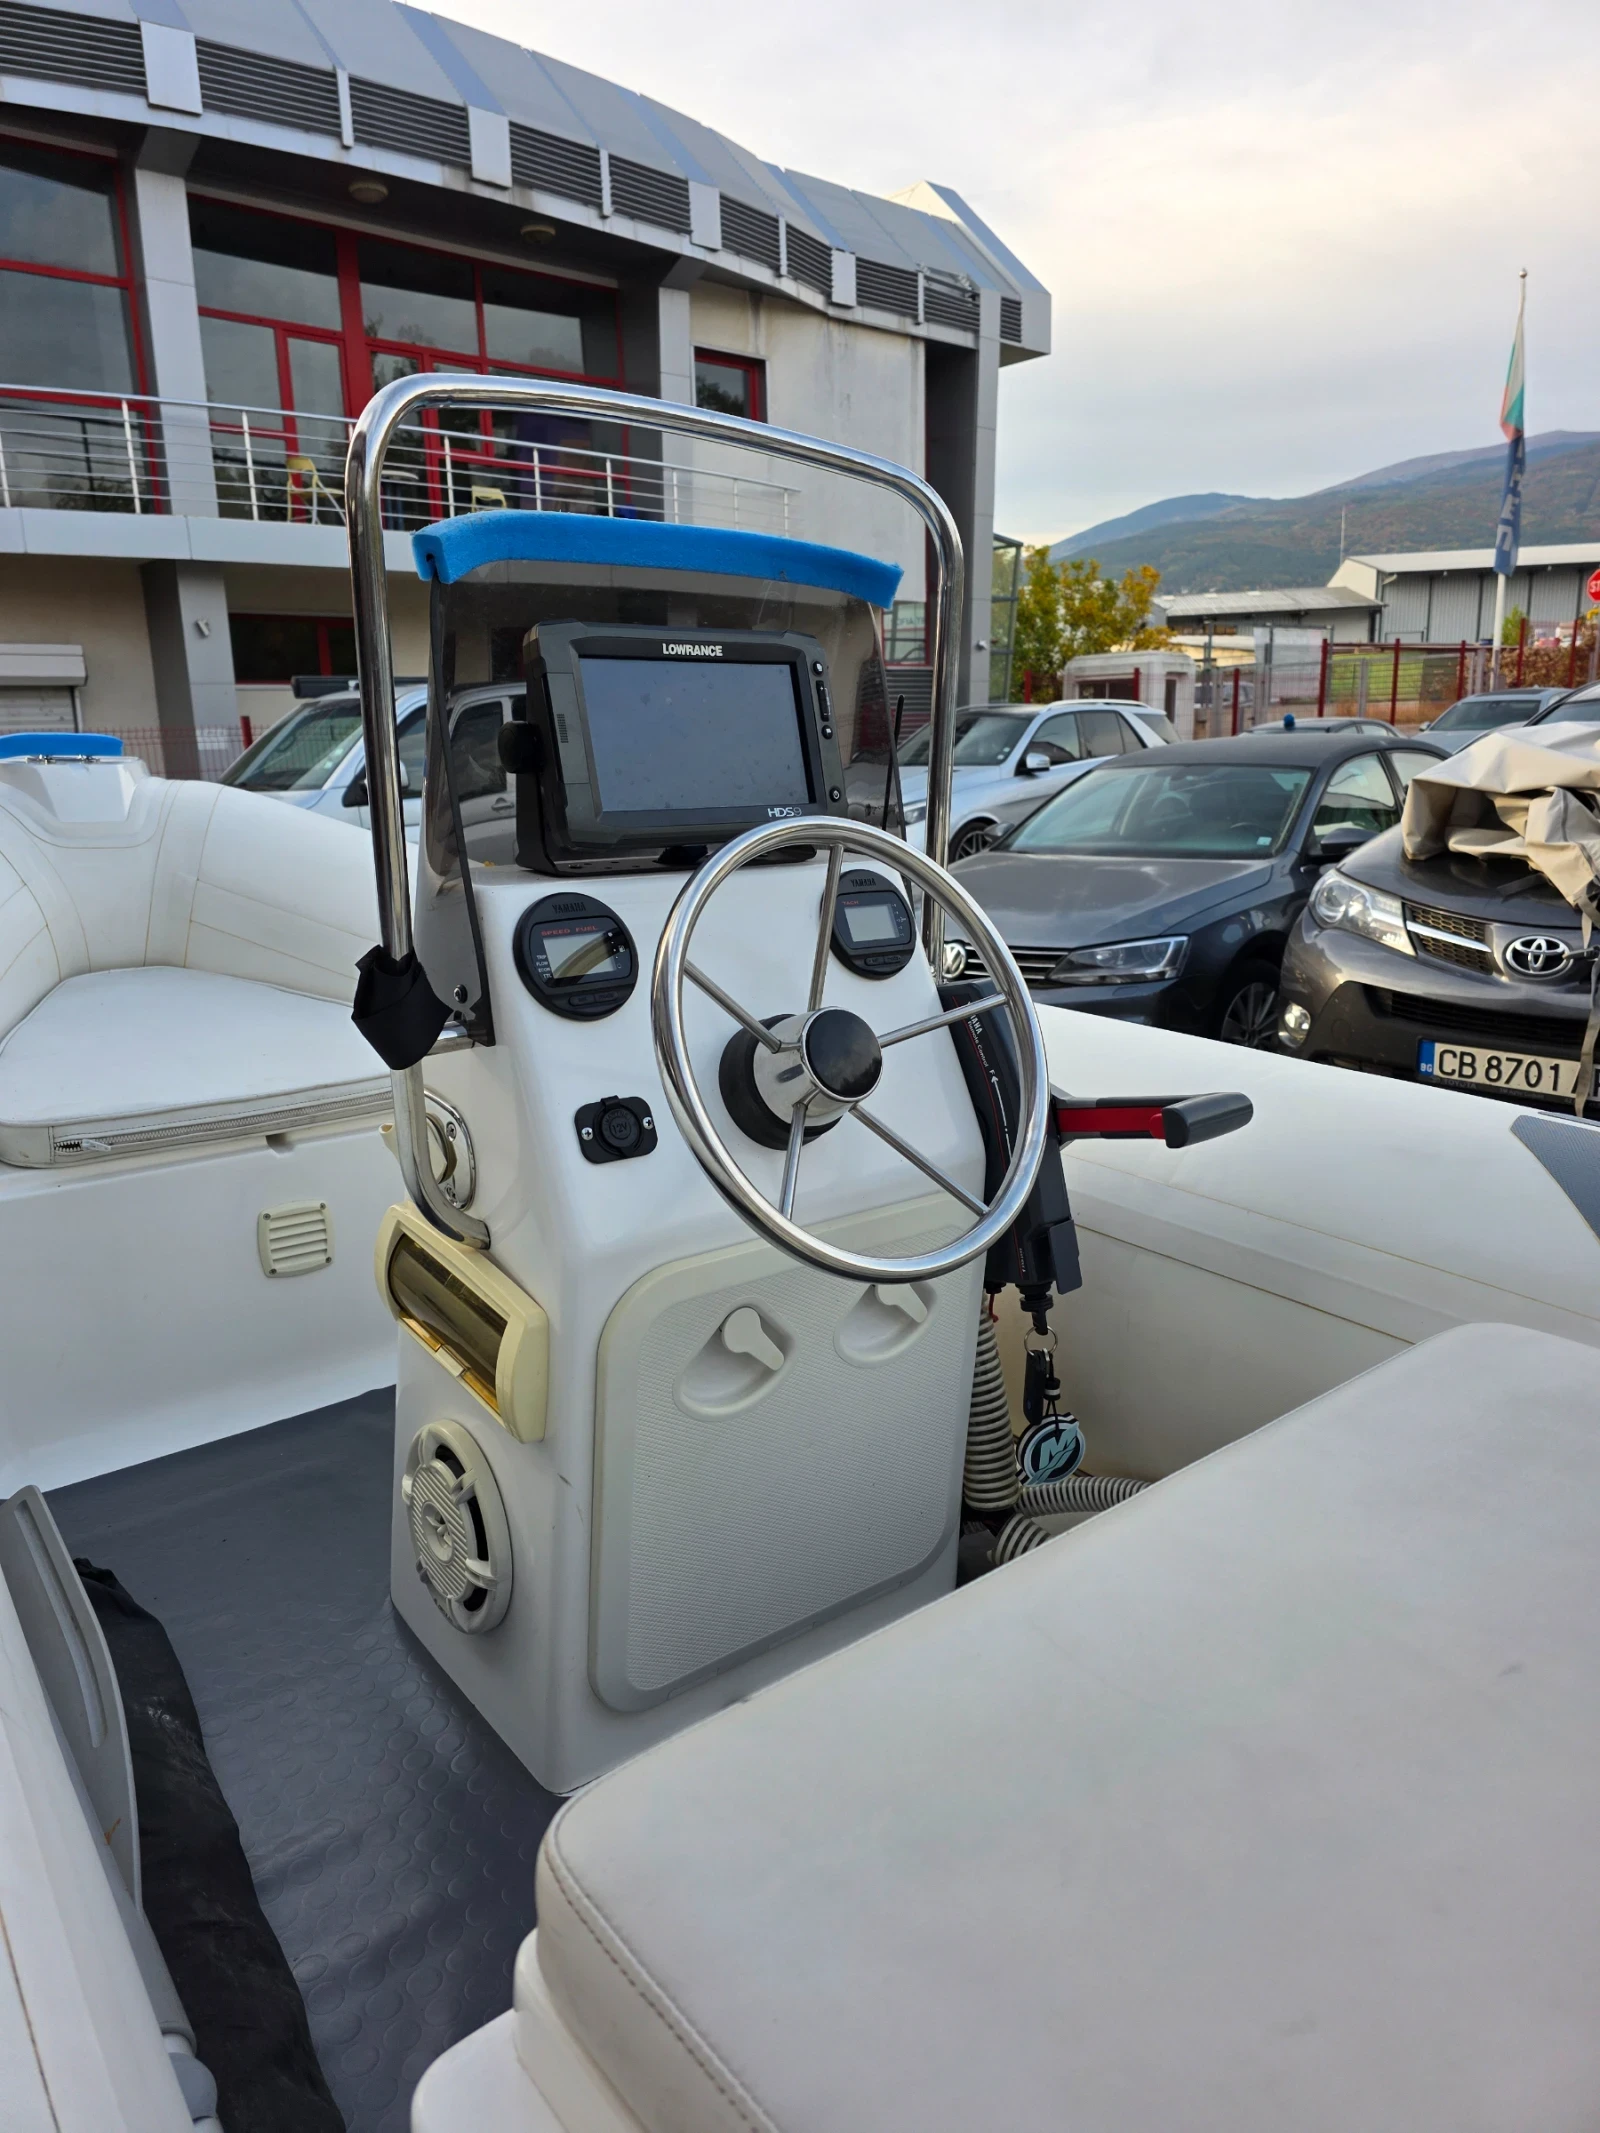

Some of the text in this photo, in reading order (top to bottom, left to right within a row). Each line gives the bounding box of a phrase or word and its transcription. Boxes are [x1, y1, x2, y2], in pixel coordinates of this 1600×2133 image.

[662, 643, 723, 657] LOWRANCE
[767, 807, 803, 818] HDS9
[850, 877, 877, 887] YAMAHA
[551, 901, 587, 914] YAMAHA
[541, 928, 570, 936] SPEED
[968, 1021, 989, 1067] Remote Control
[1420, 1063, 1433, 1073] BG
[1438, 1049, 1477, 1080] CB
[1484, 1055, 1561, 1092] 8701
